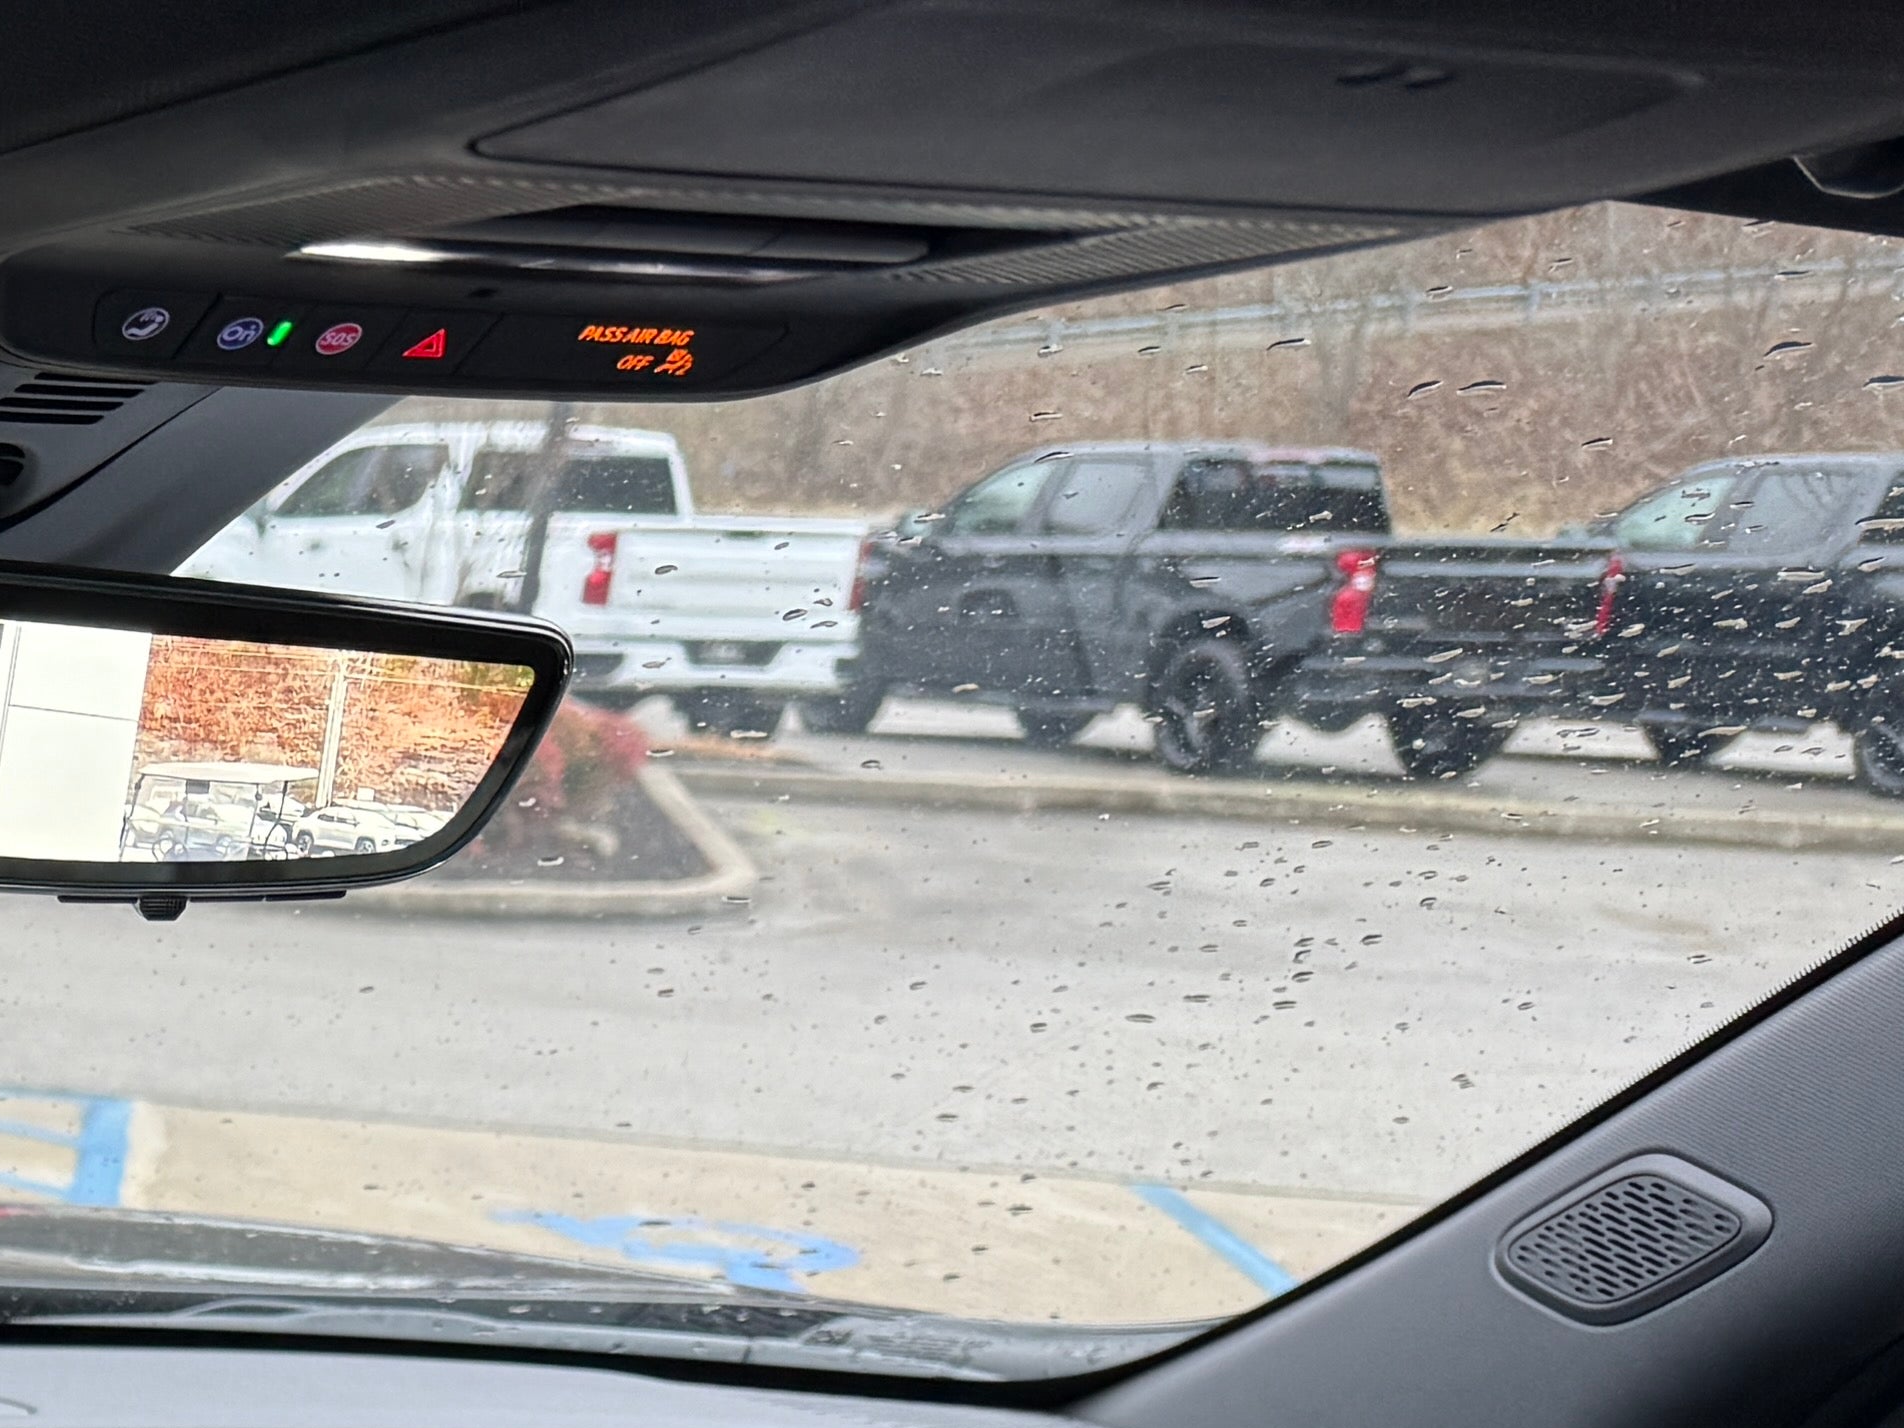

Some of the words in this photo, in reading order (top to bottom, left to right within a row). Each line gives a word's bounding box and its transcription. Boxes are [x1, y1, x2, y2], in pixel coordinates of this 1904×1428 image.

[321, 330, 356, 347] SOS
[578, 325, 628, 342] PASS
[622, 327, 657, 344] AIR
[653, 329, 695, 346] BAG
[616, 354, 654, 370] OFF
